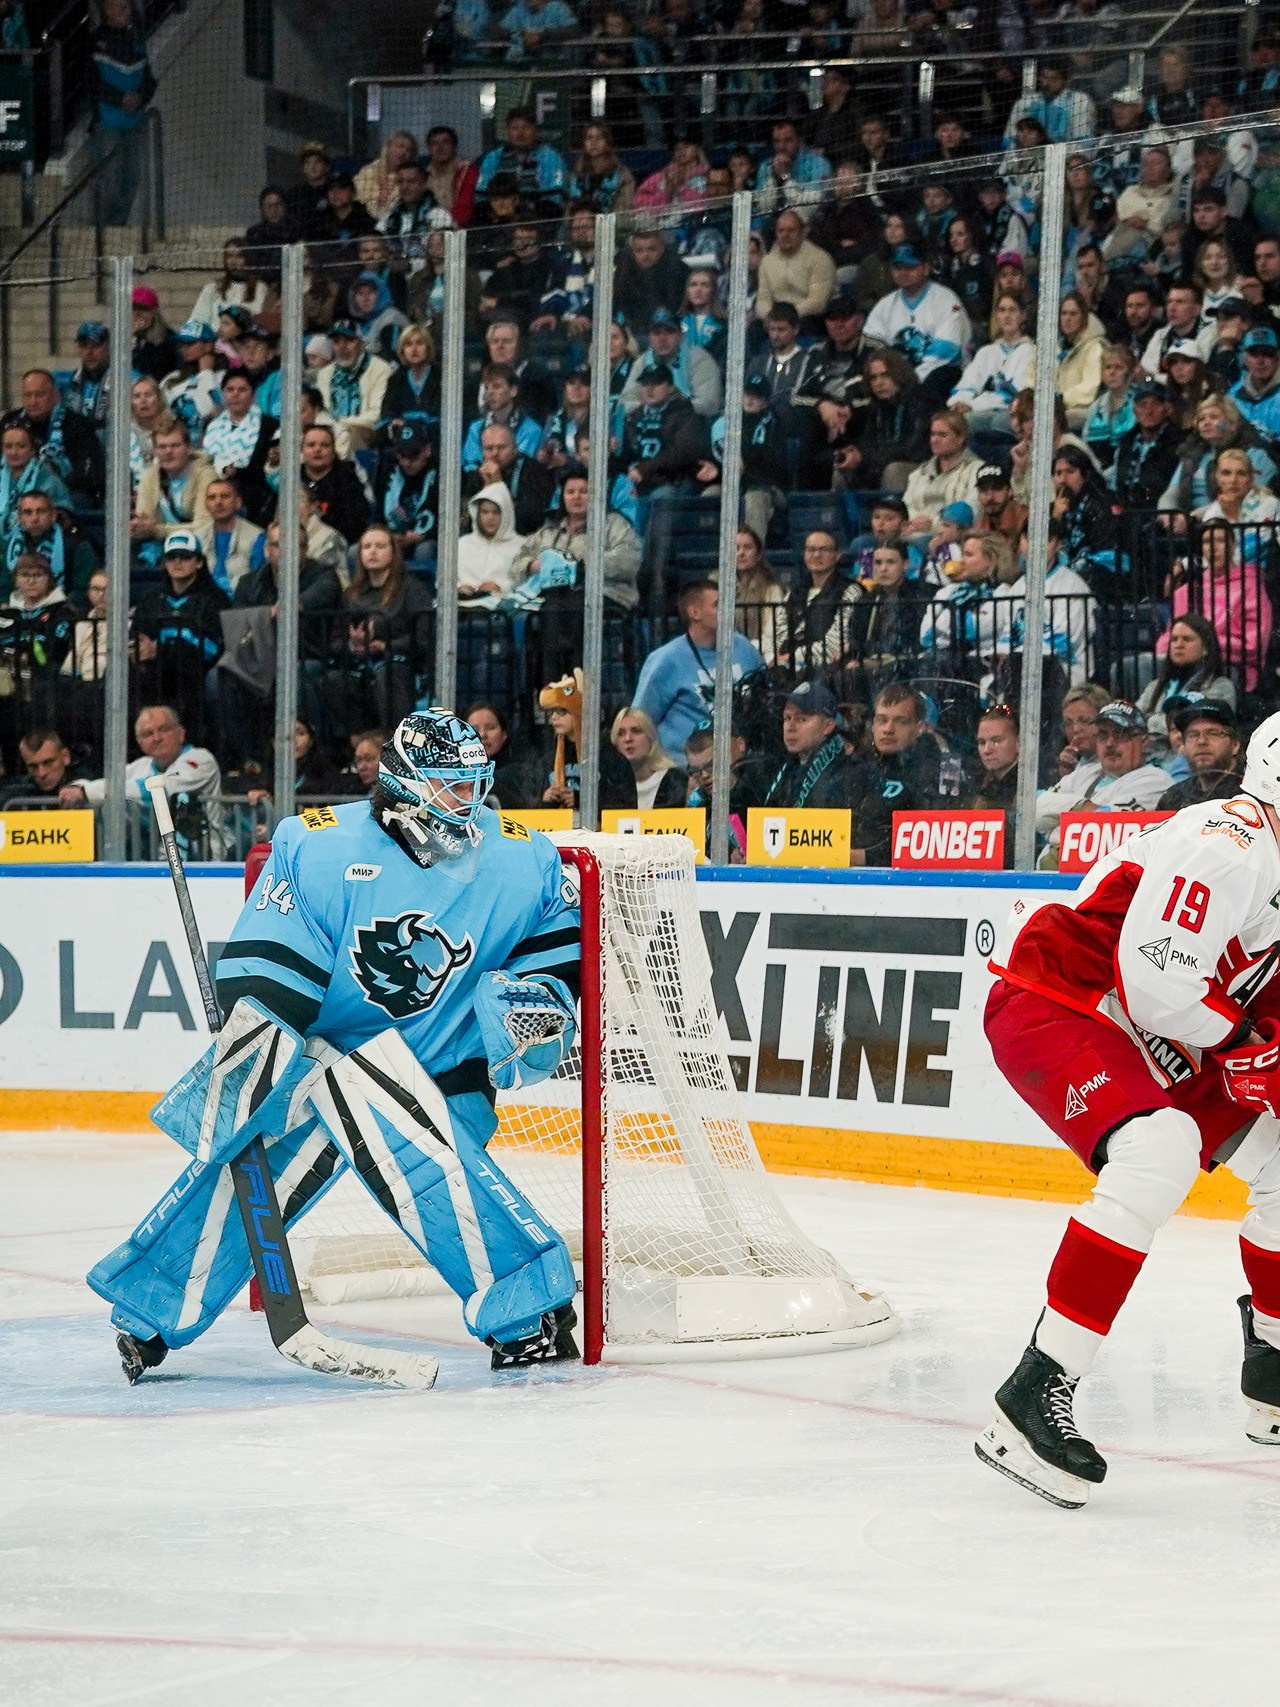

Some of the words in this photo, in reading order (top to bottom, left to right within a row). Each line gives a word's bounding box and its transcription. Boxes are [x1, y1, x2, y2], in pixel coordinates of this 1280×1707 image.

[11, 828, 70, 846] БАНК
[789, 829, 833, 847] БАНК
[894, 821, 1003, 860] FONBET
[256, 873, 296, 915] 94
[1161, 876, 1211, 934] 19
[137, 1160, 206, 1239] TRUE
[478, 1159, 550, 1245] TRUE
